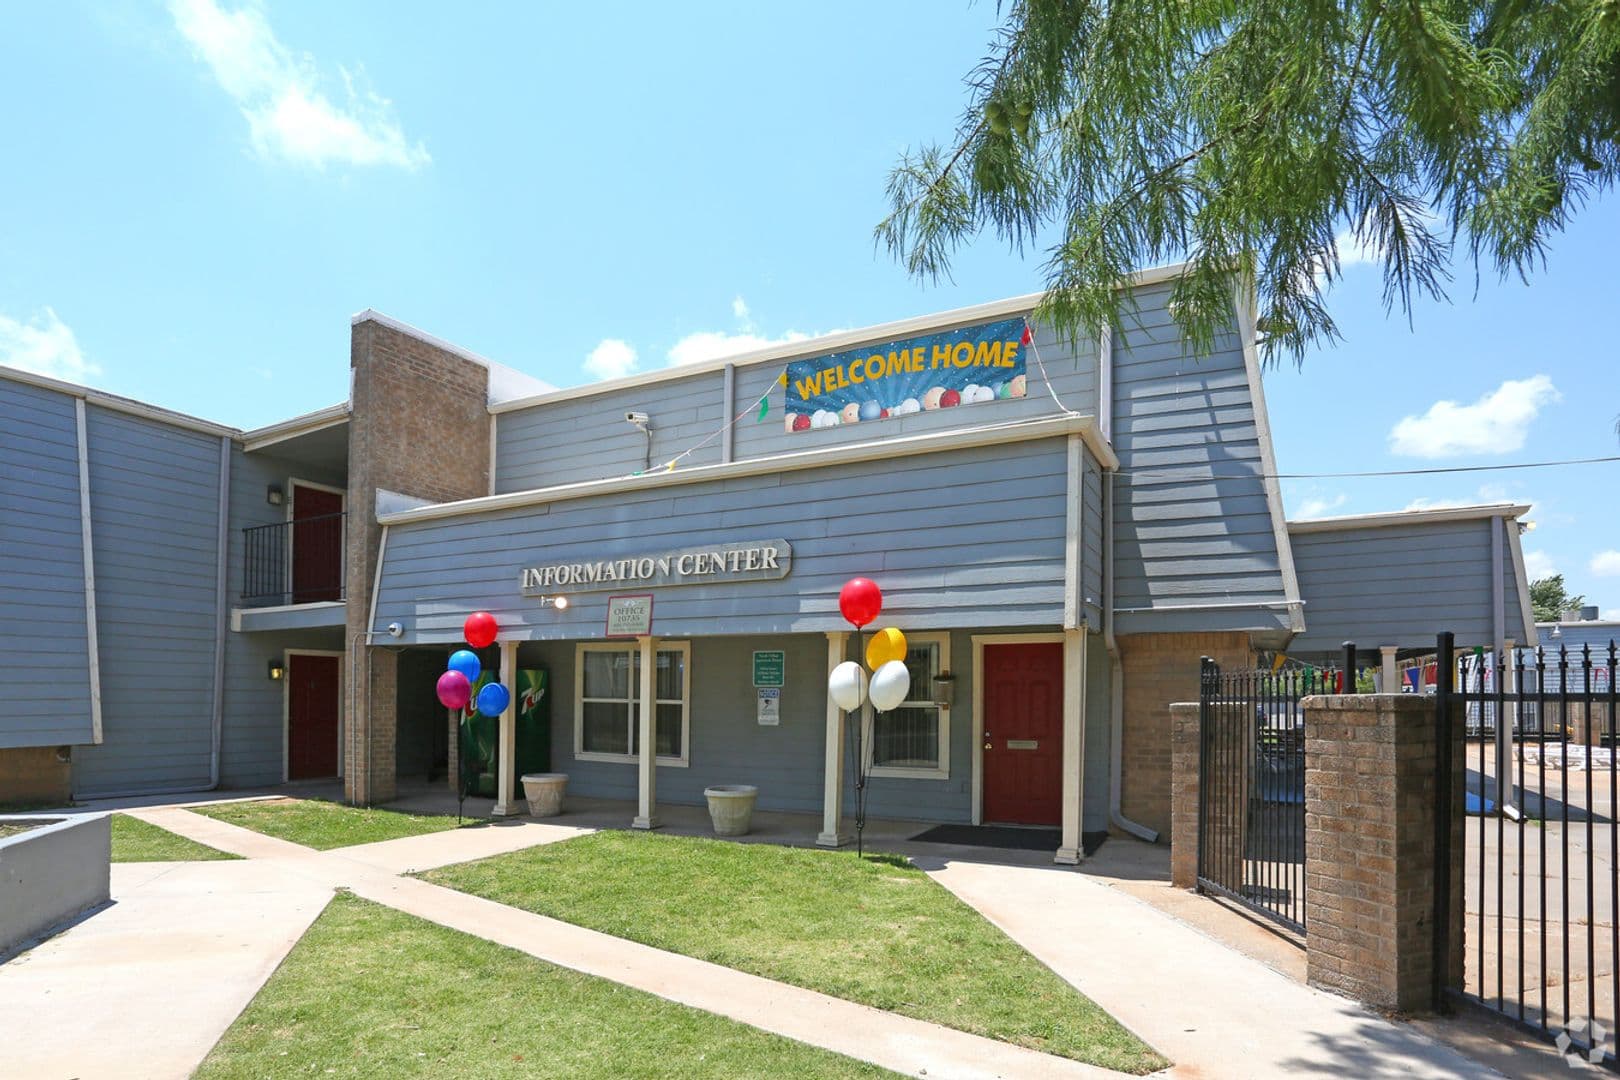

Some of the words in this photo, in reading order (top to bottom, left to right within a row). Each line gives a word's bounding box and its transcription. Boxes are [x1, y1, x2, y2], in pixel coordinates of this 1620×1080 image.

[795, 348, 926, 400] WELCOME
[931, 341, 1018, 368] HOME
[522, 557, 672, 588] INFORMATION
[678, 547, 779, 576] CENTER
[613, 606, 646, 615] OFFICE
